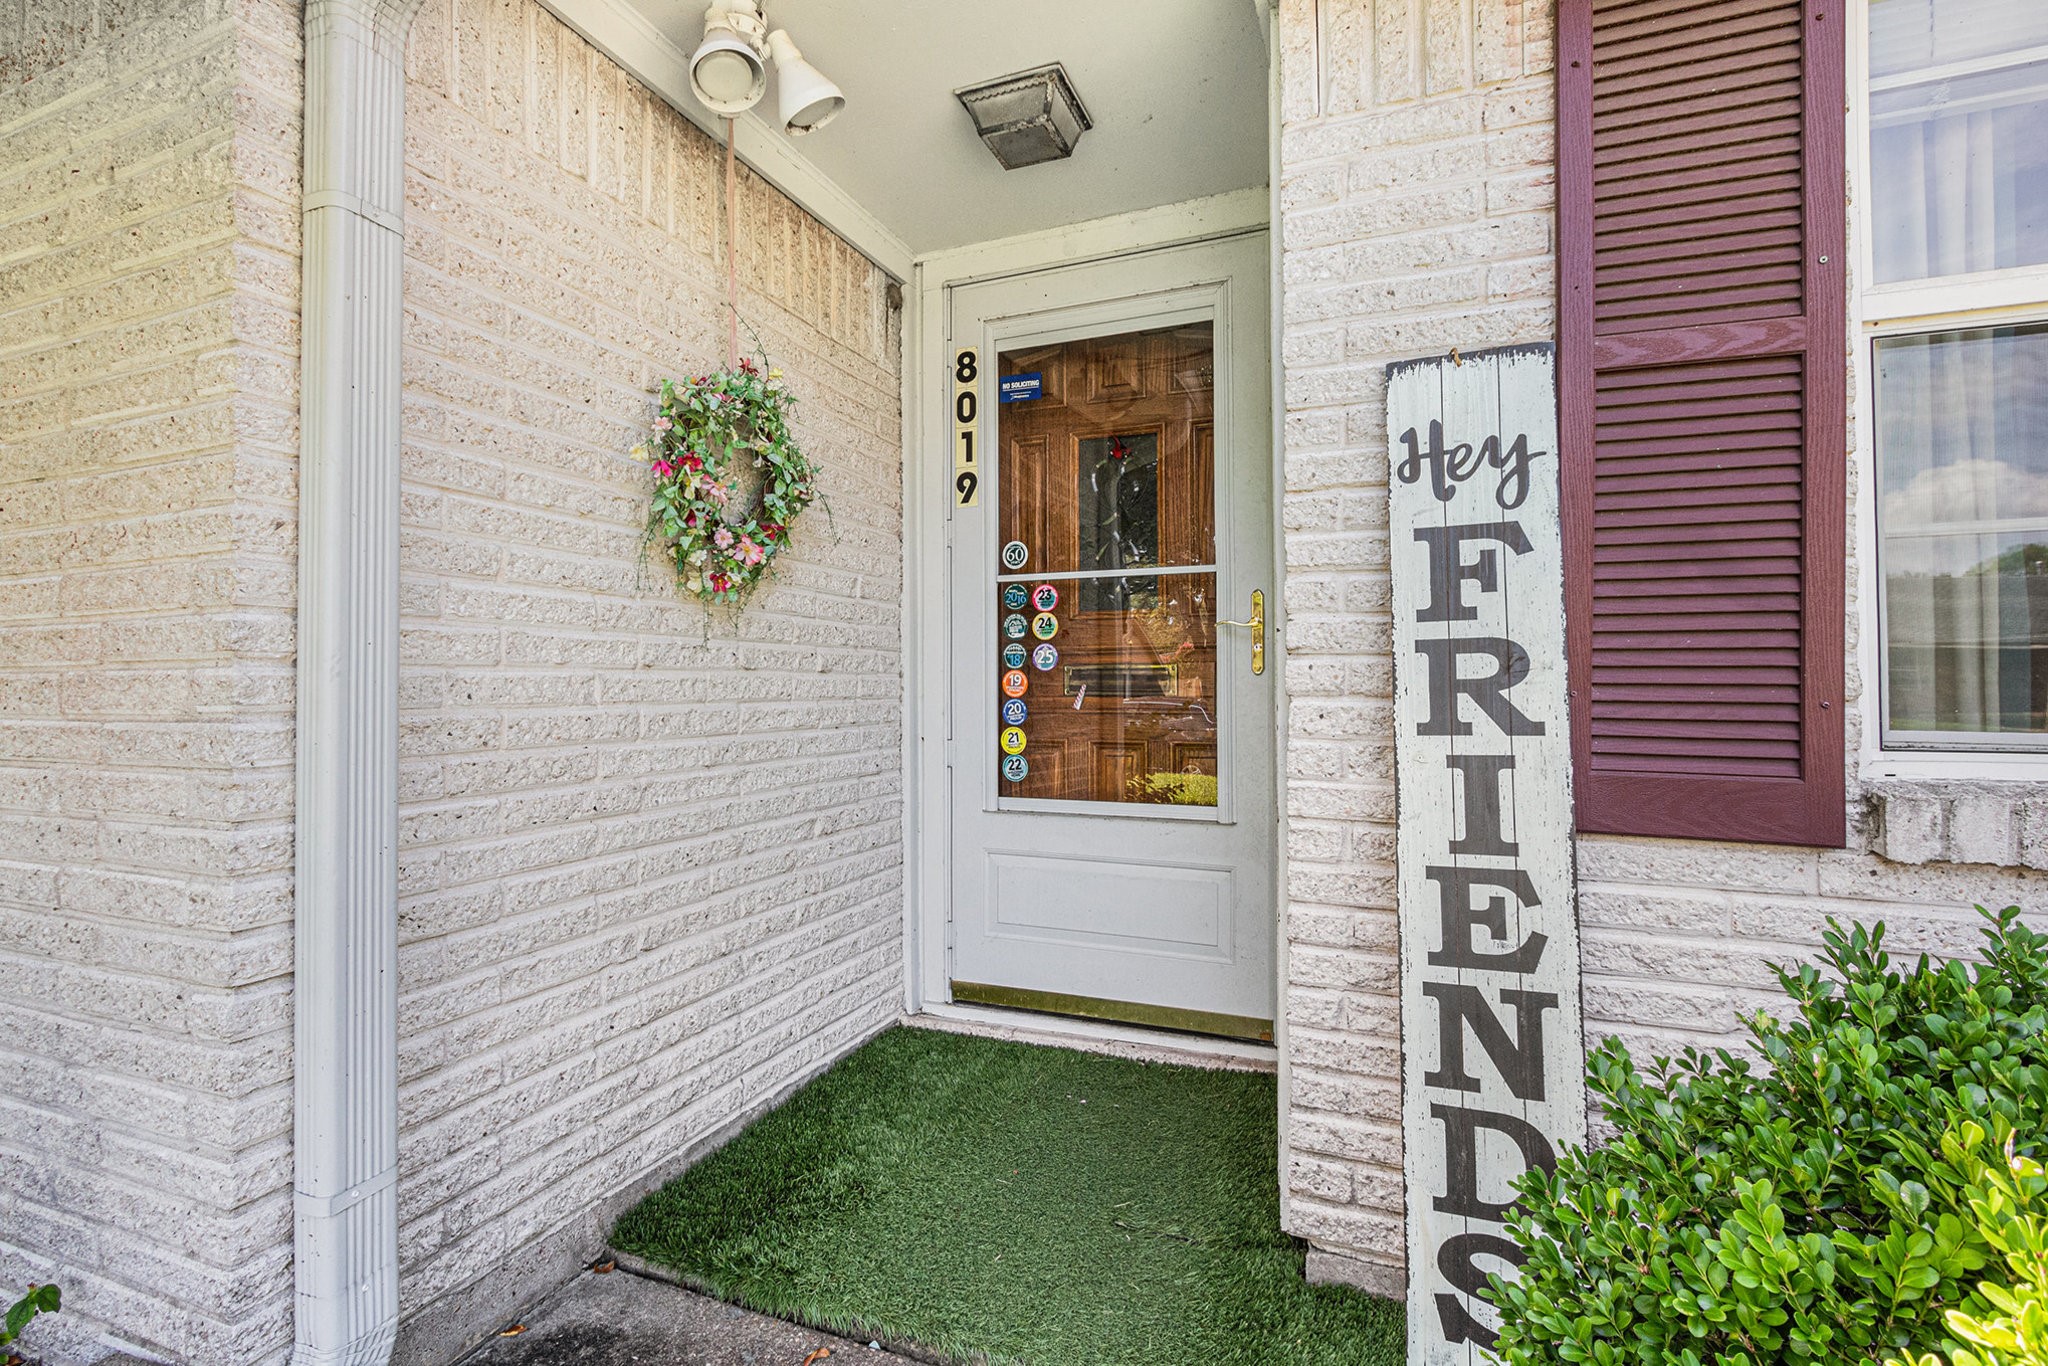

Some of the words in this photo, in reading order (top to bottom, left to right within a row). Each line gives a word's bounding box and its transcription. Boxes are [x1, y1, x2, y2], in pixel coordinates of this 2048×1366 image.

[1002, 382, 1010, 390] NO
[1011, 379, 1040, 389] SOLICITING
[956, 351, 978, 504] 8019
[1397, 419, 1547, 510] Hey
[1006, 548, 1024, 562] 60
[1005, 592, 1027, 604] 2016
[1038, 589, 1052, 601] 23
[1038, 617, 1052, 629] 24
[1037, 650, 1054, 664] 25
[1009, 674, 1022, 686] 19
[1008, 703, 1022, 715] 20
[1008, 732, 1019, 743] 21
[1008, 758, 1022, 770] 22
